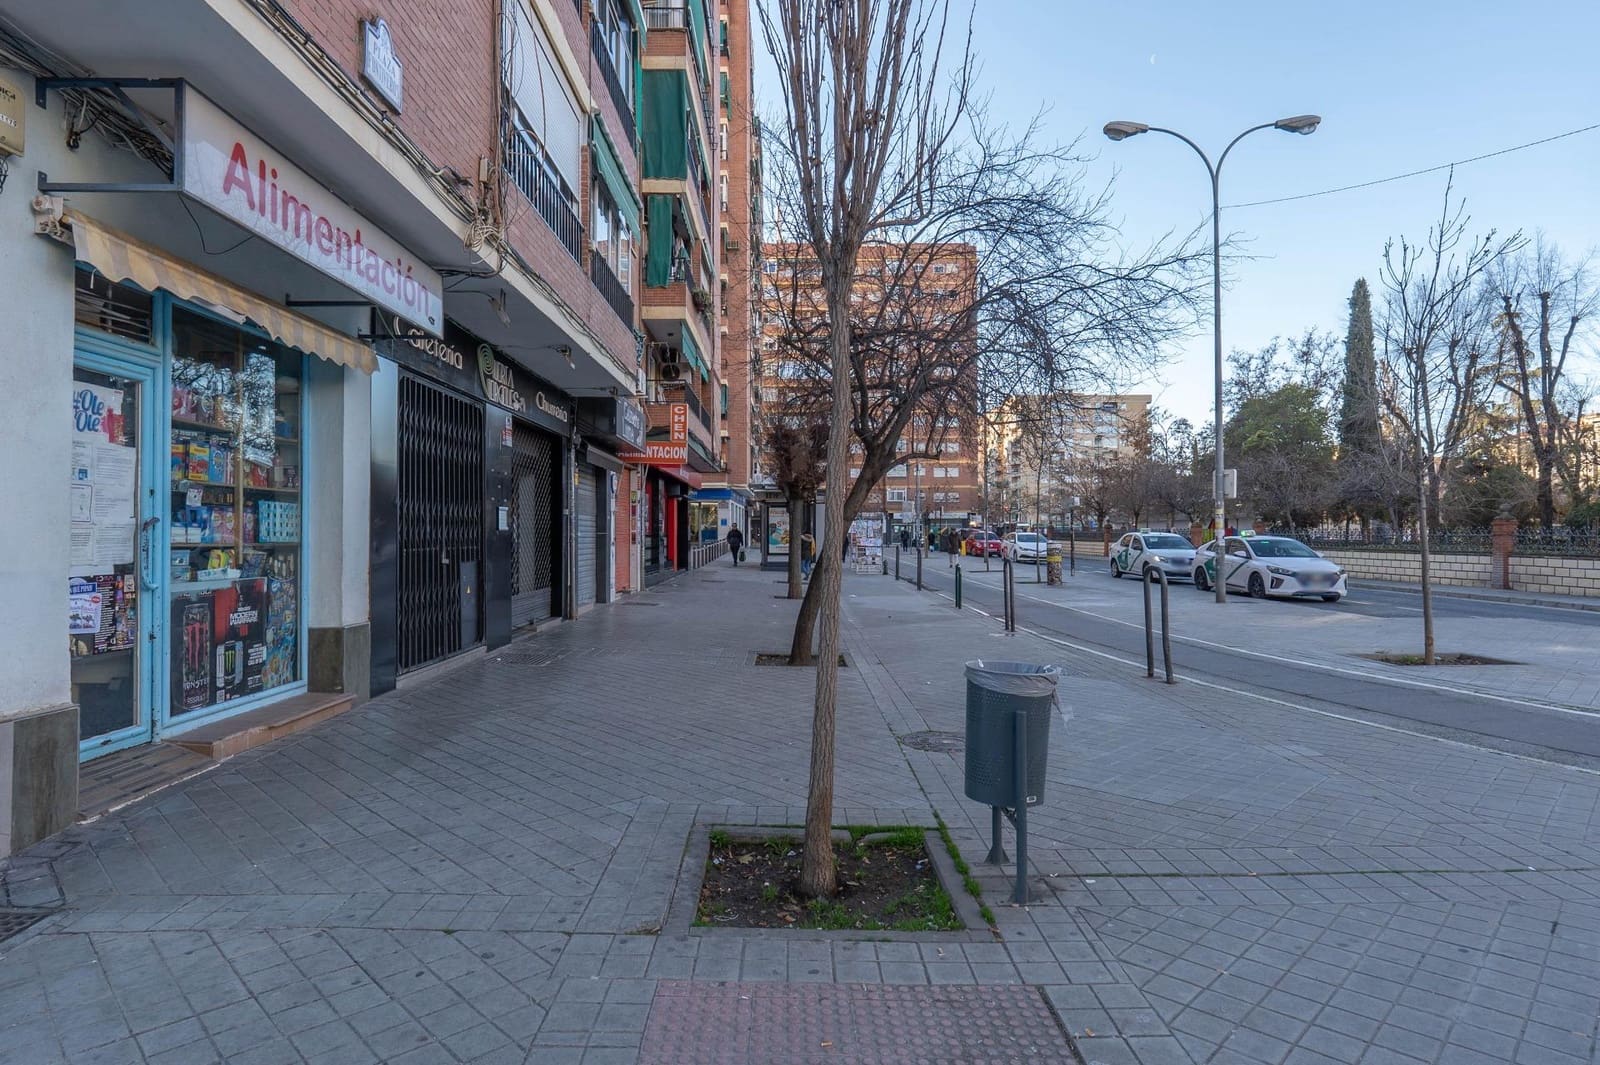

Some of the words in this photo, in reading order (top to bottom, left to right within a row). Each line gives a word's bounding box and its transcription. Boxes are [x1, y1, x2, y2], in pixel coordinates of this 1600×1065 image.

[222, 142, 430, 318] Alimentación
[536, 391, 568, 423] Churrería
[673, 406, 685, 440] CHEN
